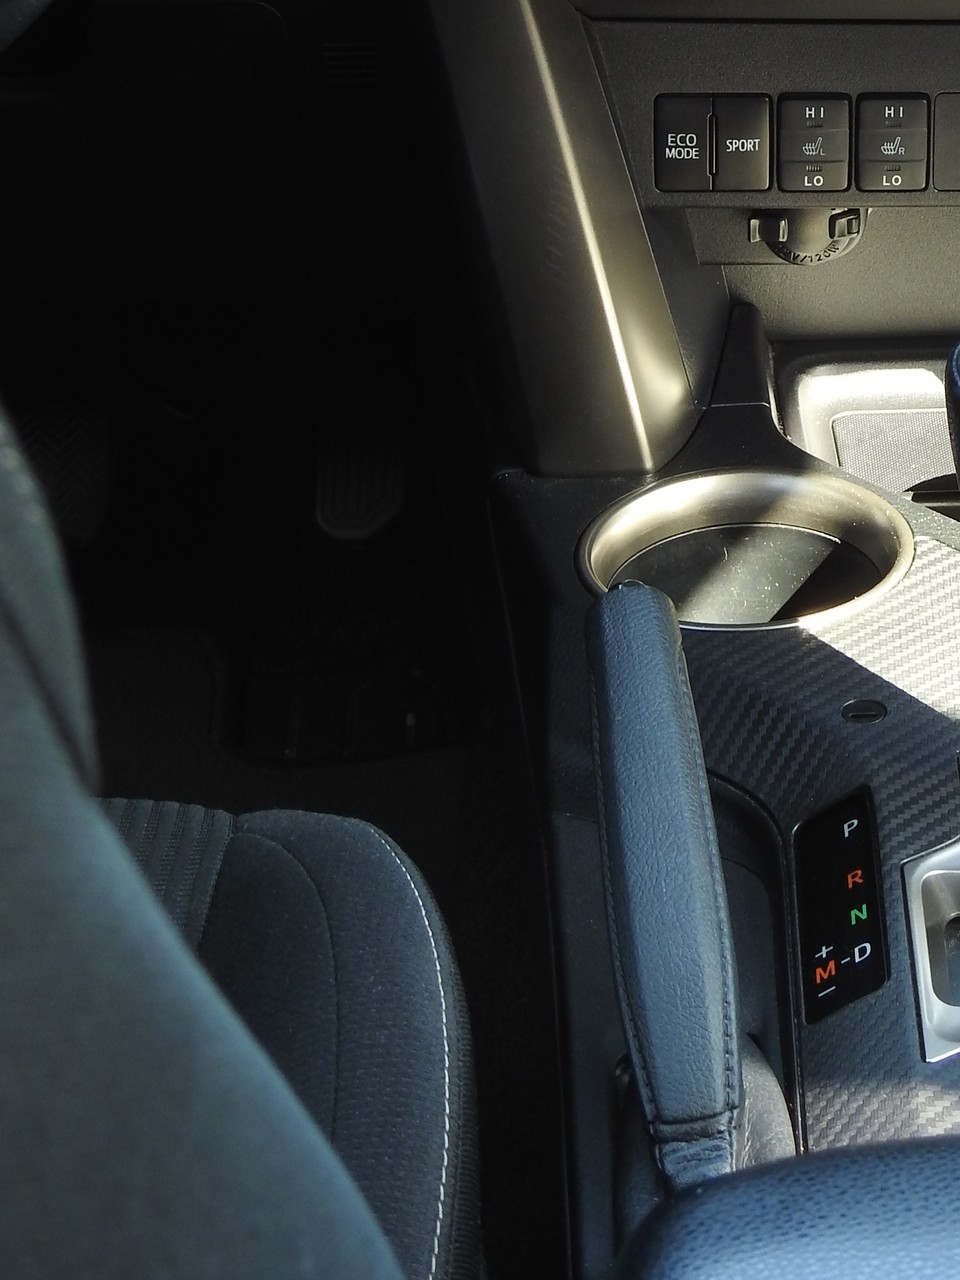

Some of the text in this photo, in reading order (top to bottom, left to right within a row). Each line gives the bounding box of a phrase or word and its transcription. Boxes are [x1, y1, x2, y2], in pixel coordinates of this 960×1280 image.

[667, 133, 697, 146] ECO
[726, 138, 761, 152] SPORT
[665, 147, 700, 160] MODE
[804, 175, 824, 187] LO
[882, 175, 902, 186] LO
[843, 819, 859, 839] P
[847, 870, 864, 889] R
[850, 903, 868, 926] N
